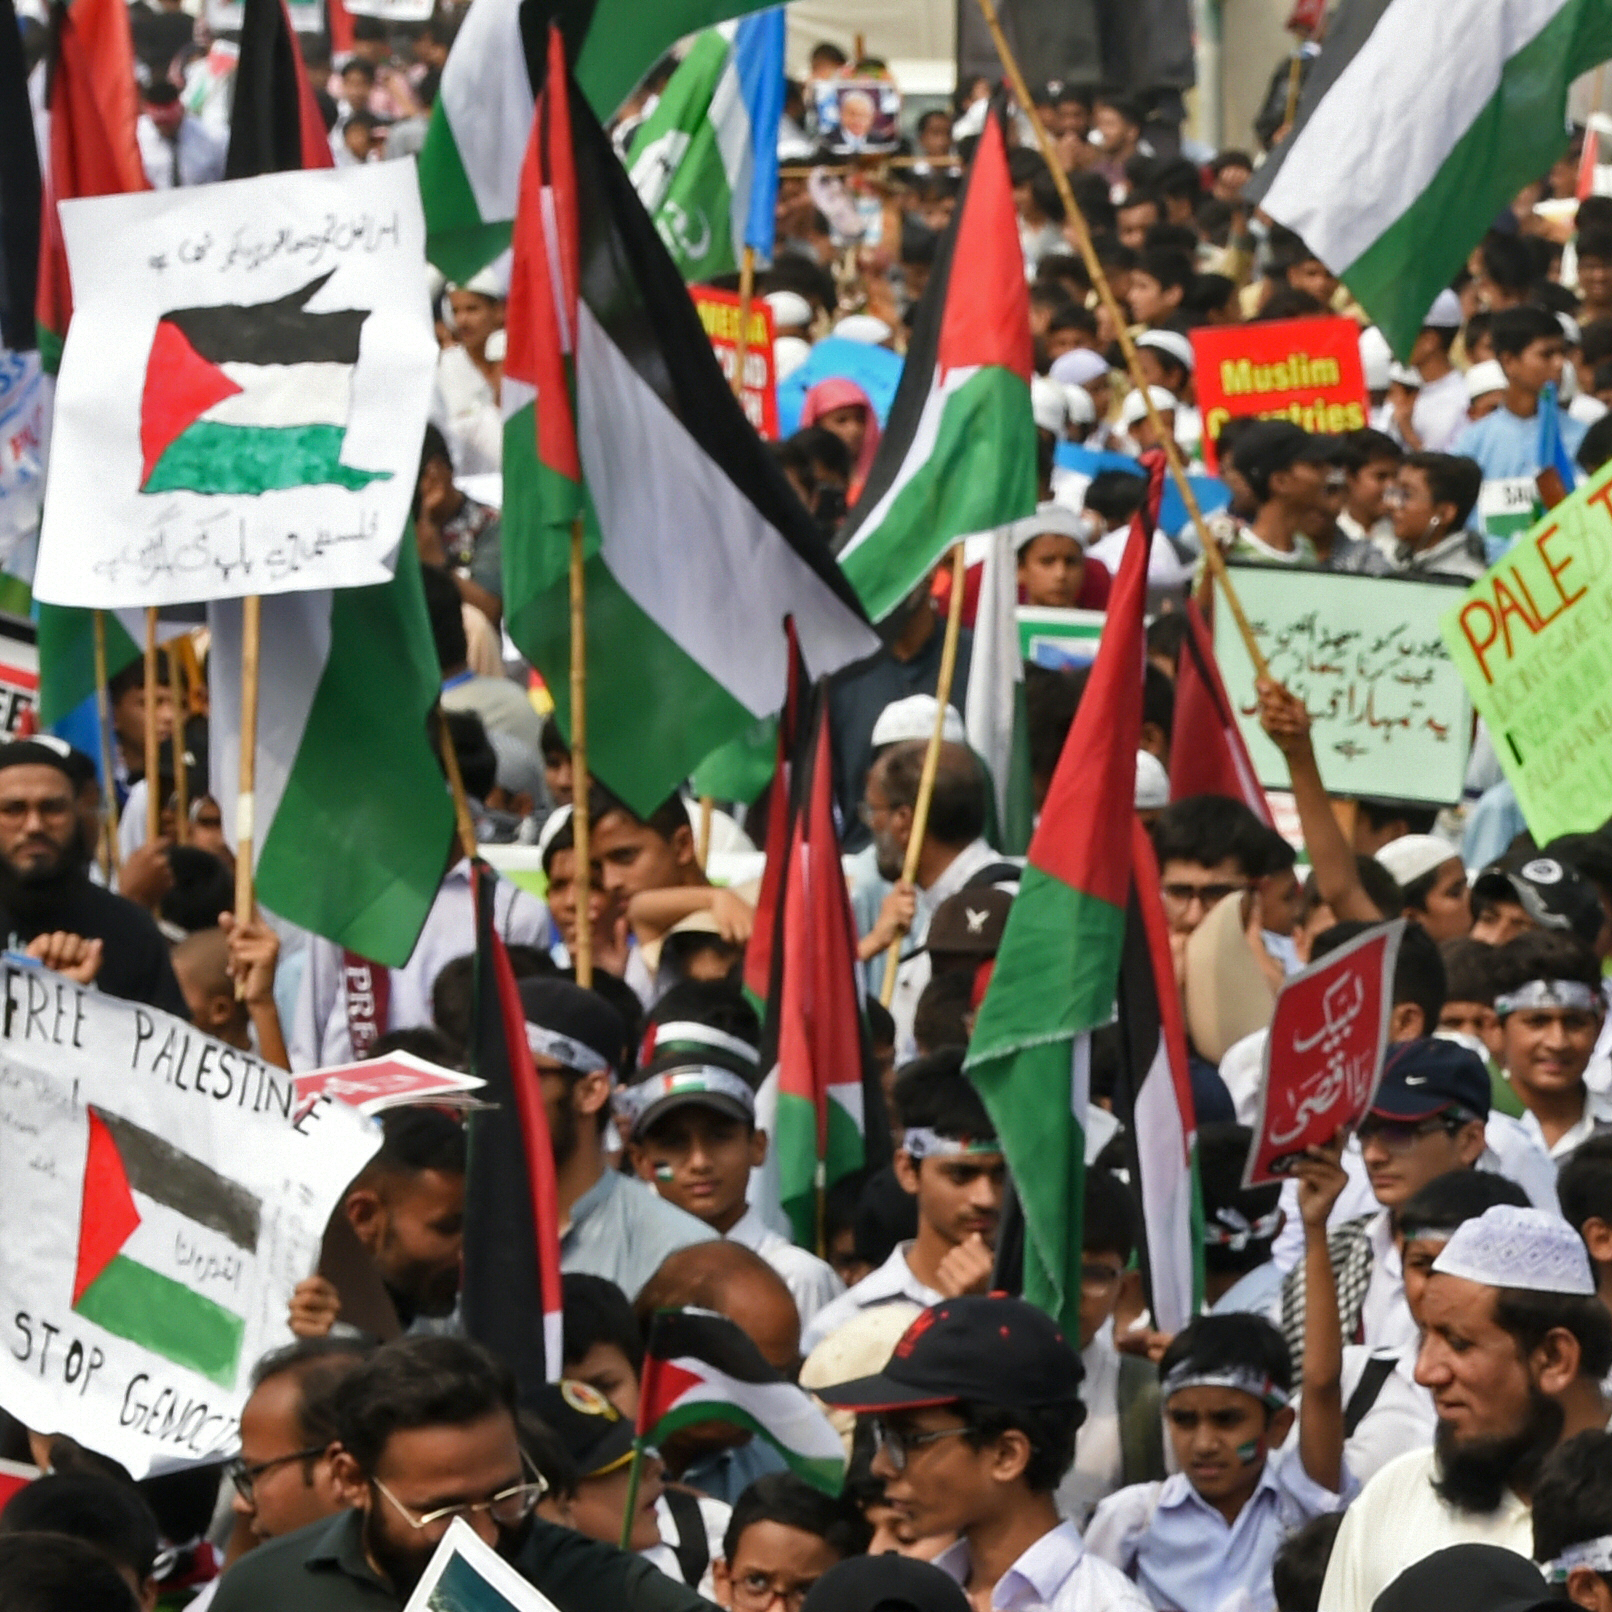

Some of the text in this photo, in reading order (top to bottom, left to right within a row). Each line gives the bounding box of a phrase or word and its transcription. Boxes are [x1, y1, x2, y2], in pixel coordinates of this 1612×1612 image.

[1220, 352, 1340, 396] Muslim
[1207, 397, 1366, 440] Ctries
[3, 966, 87, 1049] FREE
[131, 1008, 335, 1137] PALESTINE
[10, 1310, 105, 1395] STOP
